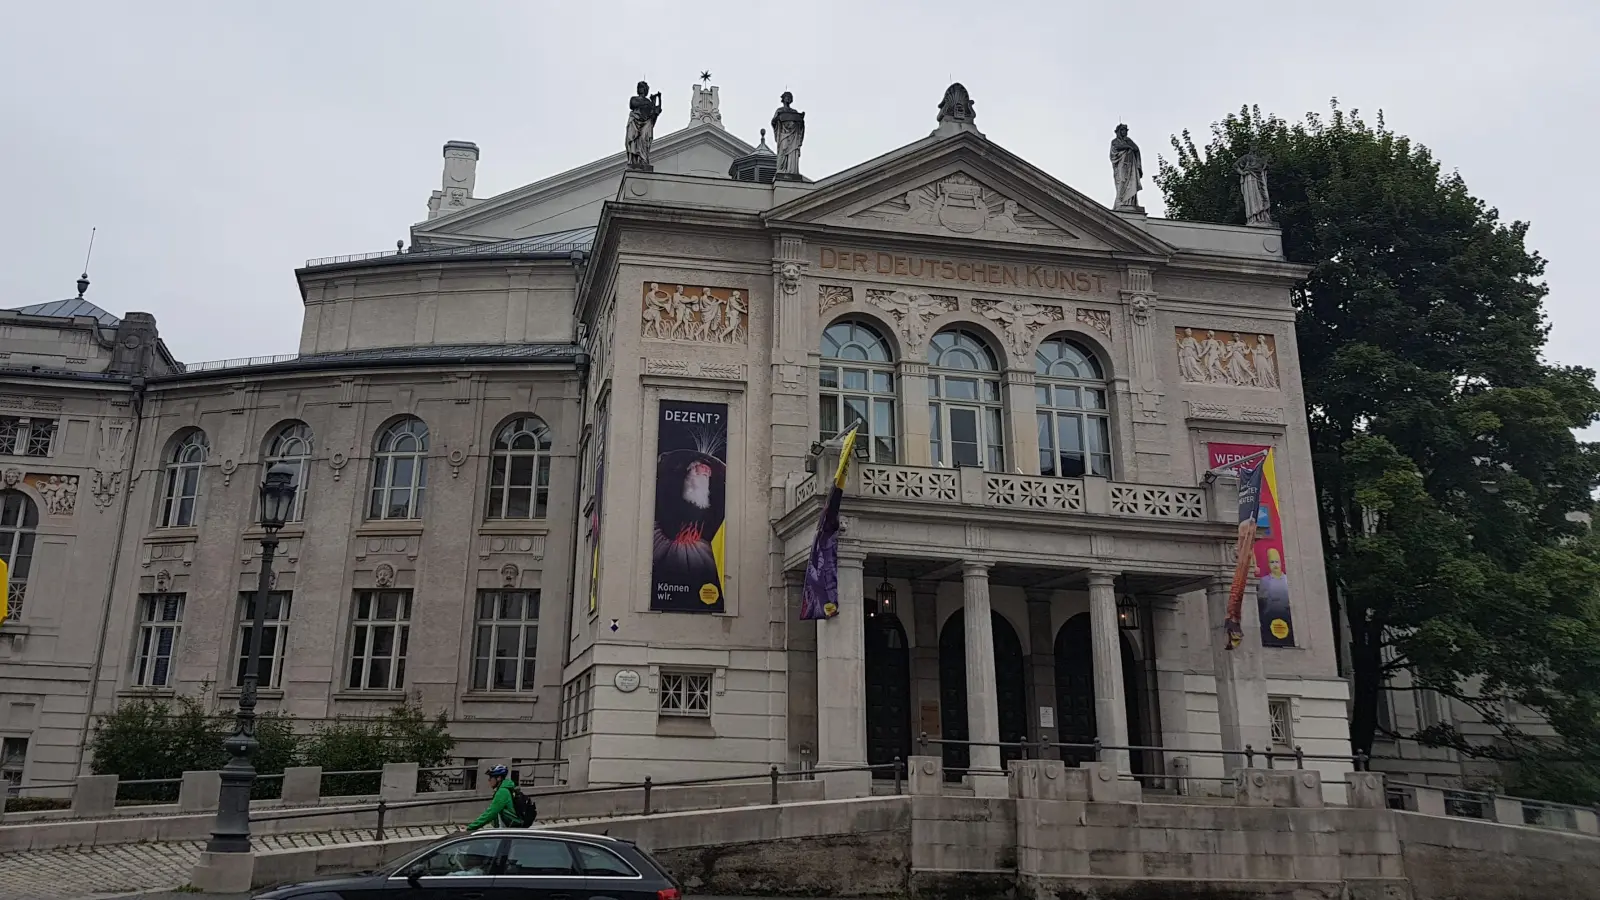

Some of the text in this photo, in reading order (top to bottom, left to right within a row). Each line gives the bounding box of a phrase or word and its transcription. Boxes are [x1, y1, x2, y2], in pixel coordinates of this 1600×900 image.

[820, 247, 1107, 293] DER DEUTSCHEN KUNST
[665, 410, 720, 424] DEZENT?
[657, 582, 690, 593] Können
[657, 592, 673, 601] wir.
